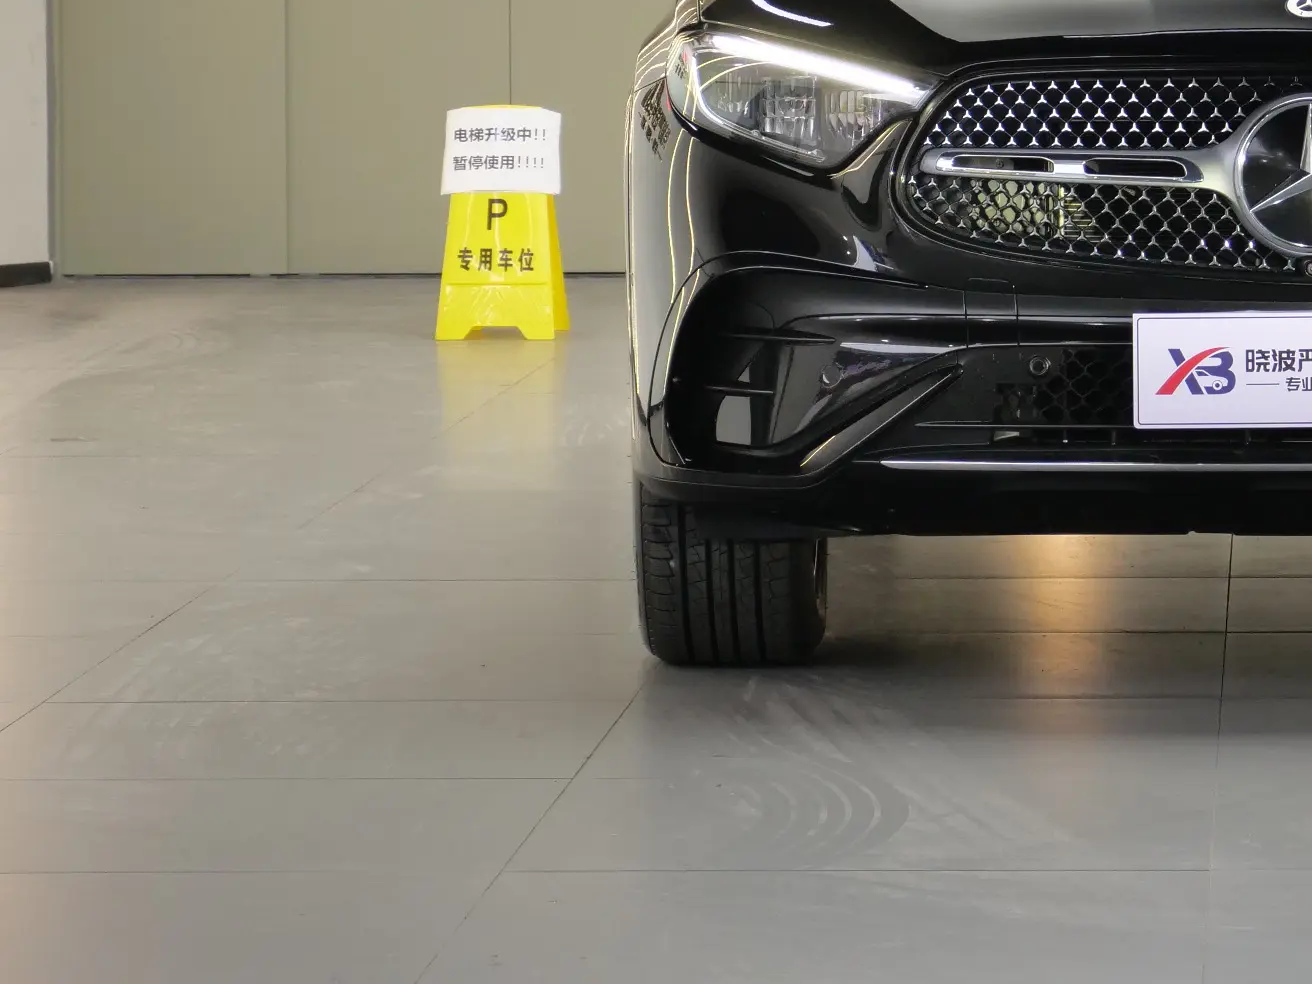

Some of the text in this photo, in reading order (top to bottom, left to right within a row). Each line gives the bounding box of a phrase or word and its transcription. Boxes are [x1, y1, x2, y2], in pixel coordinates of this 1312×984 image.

[487, 199, 508, 230] P
[457, 247, 534, 272] 专用车位
